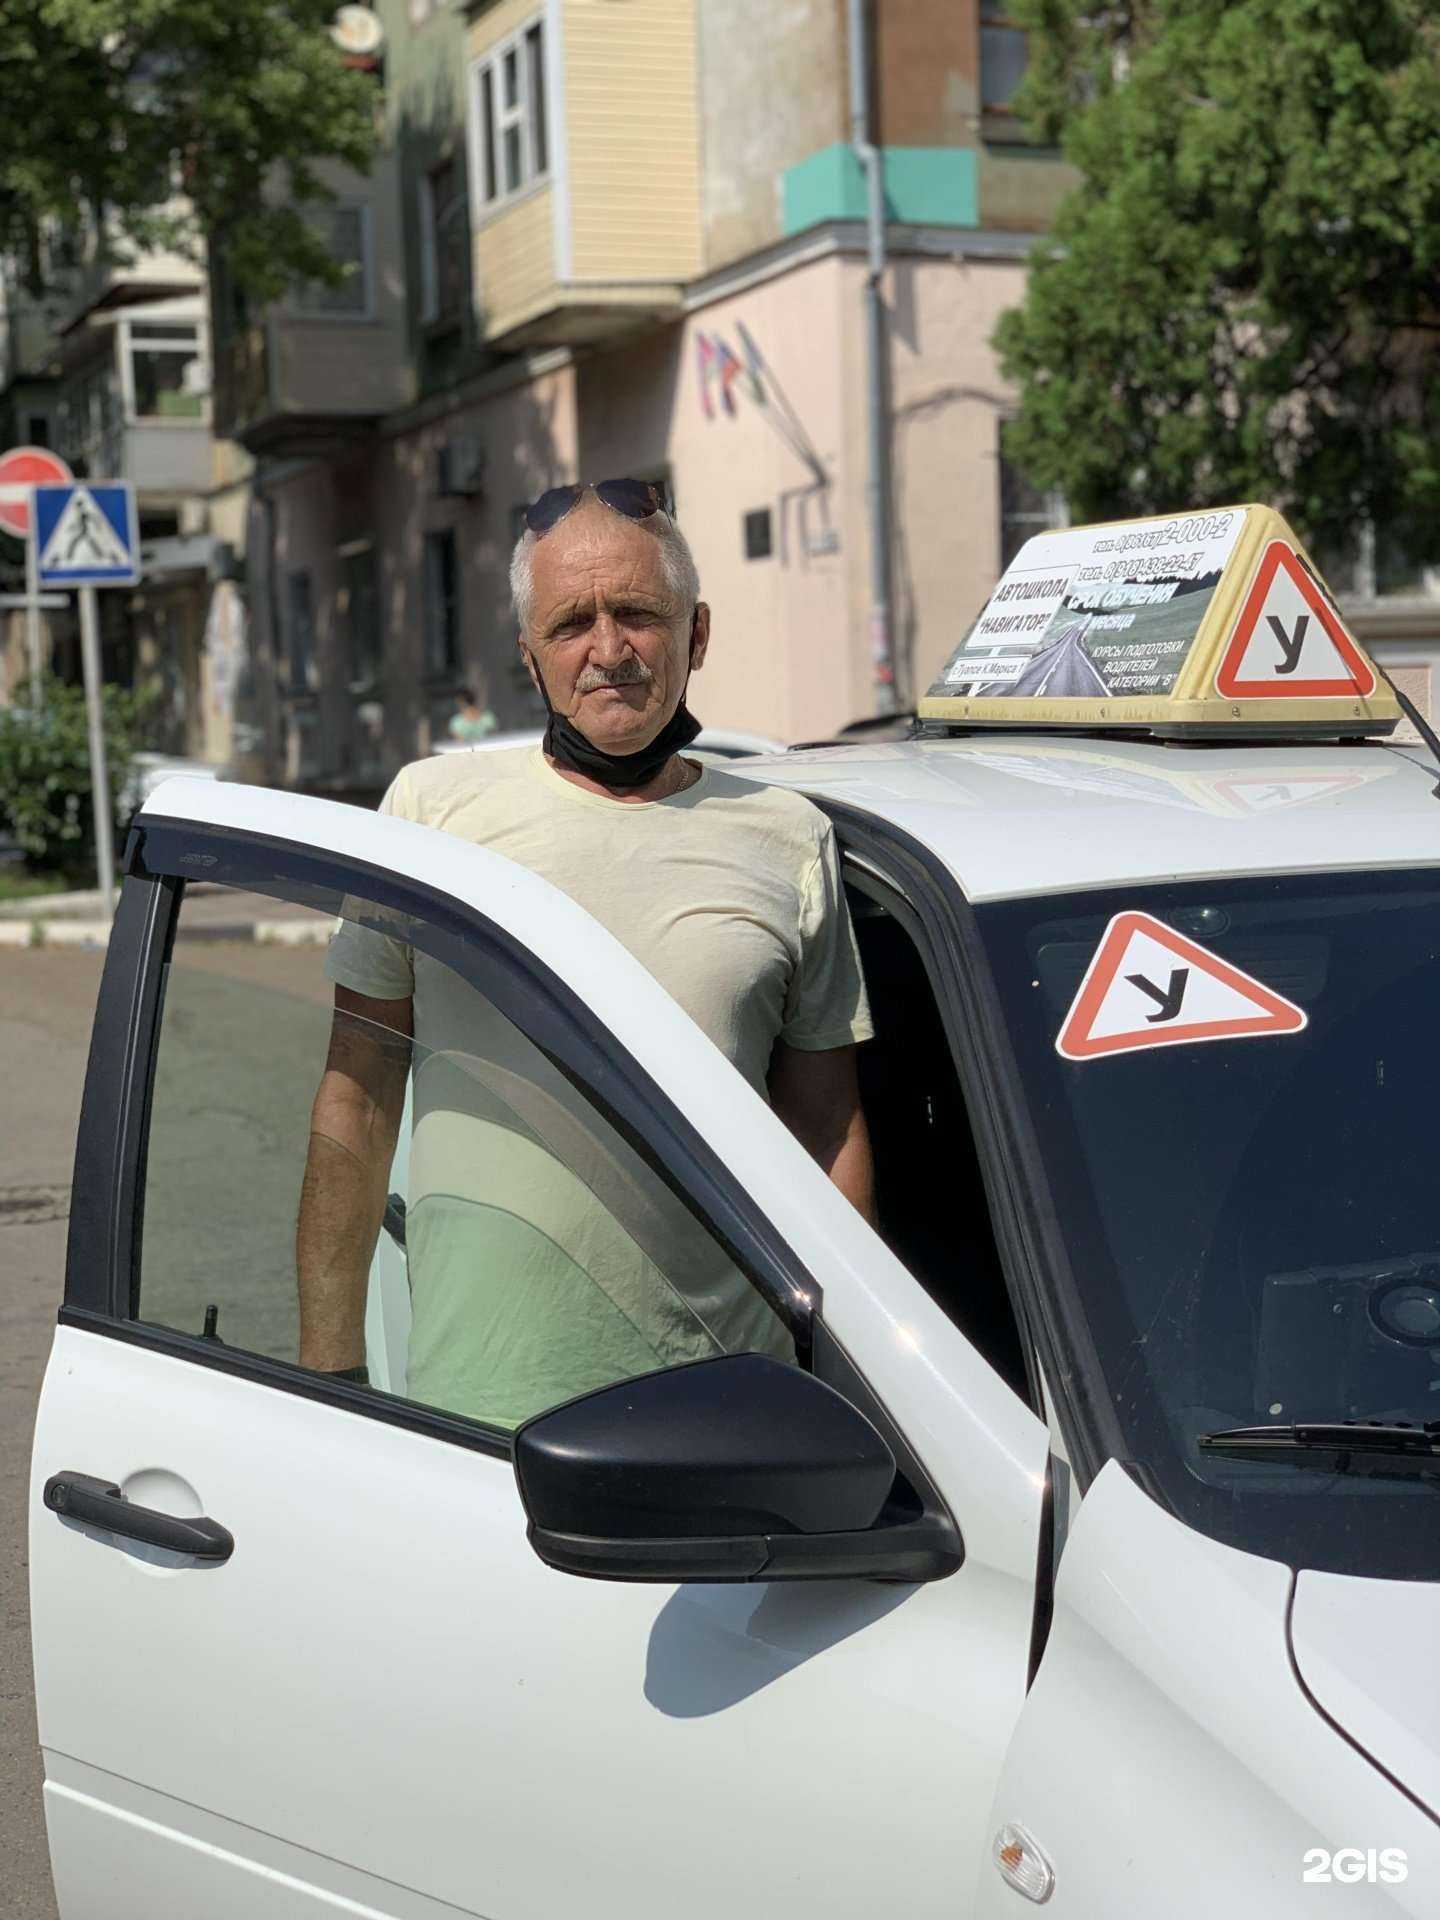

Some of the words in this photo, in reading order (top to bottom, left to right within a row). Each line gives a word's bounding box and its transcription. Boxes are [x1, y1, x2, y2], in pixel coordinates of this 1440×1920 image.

[994, 578, 1068, 601] АВТОШКОЛА
[1091, 644, 1125, 658] КУРСЫ
[1123, 640, 1185, 658] ПОДГОТОВКИ
[1265, 615, 1310, 675] У
[1103, 658, 1158, 674] ВОДИТЕЛЕЙ
[1107, 675, 1159, 688] КАТЕГОРИИ
[1124, 968, 1190, 1023] У
